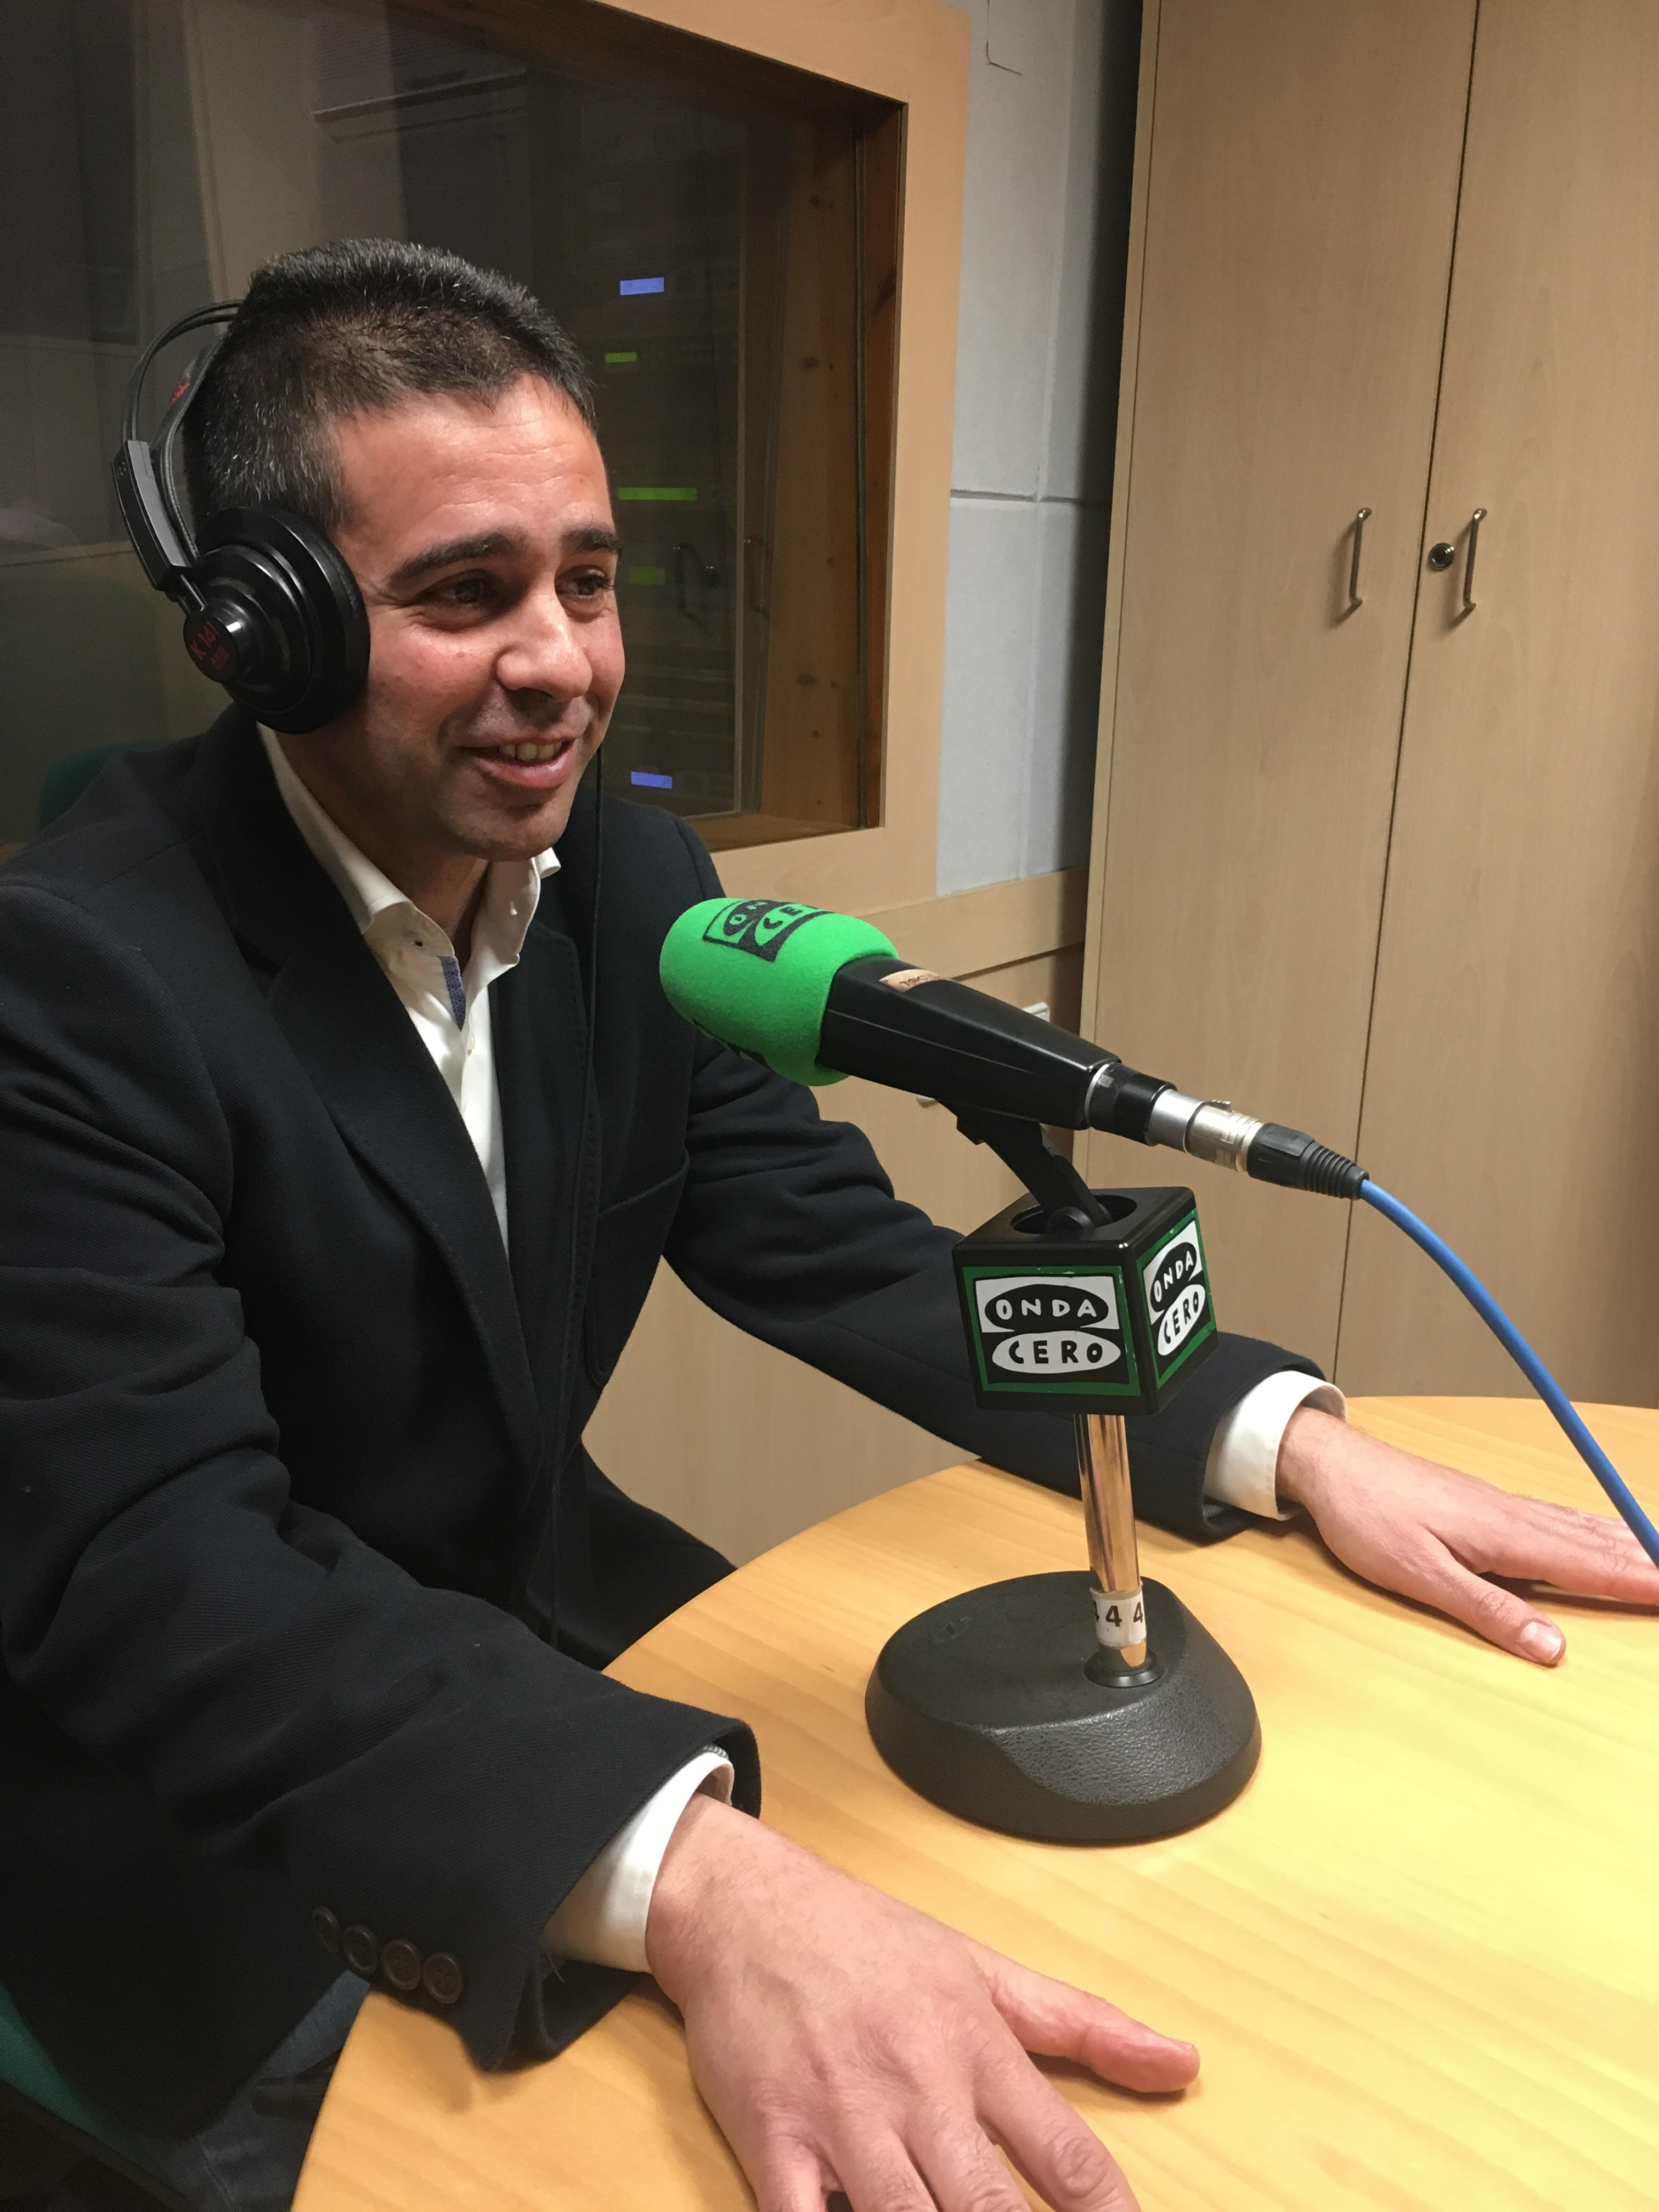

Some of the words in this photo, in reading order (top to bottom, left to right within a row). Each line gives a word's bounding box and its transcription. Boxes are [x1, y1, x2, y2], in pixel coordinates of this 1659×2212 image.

[763, 906, 803, 929] CE
[1154, 1250, 1193, 1303] ONDA
[995, 1298, 1097, 1320] ONDA
[1164, 1291, 1199, 1344] CERO
[1008, 1340, 1103, 1364] CERO
[1105, 1605, 1122, 1627] 4
